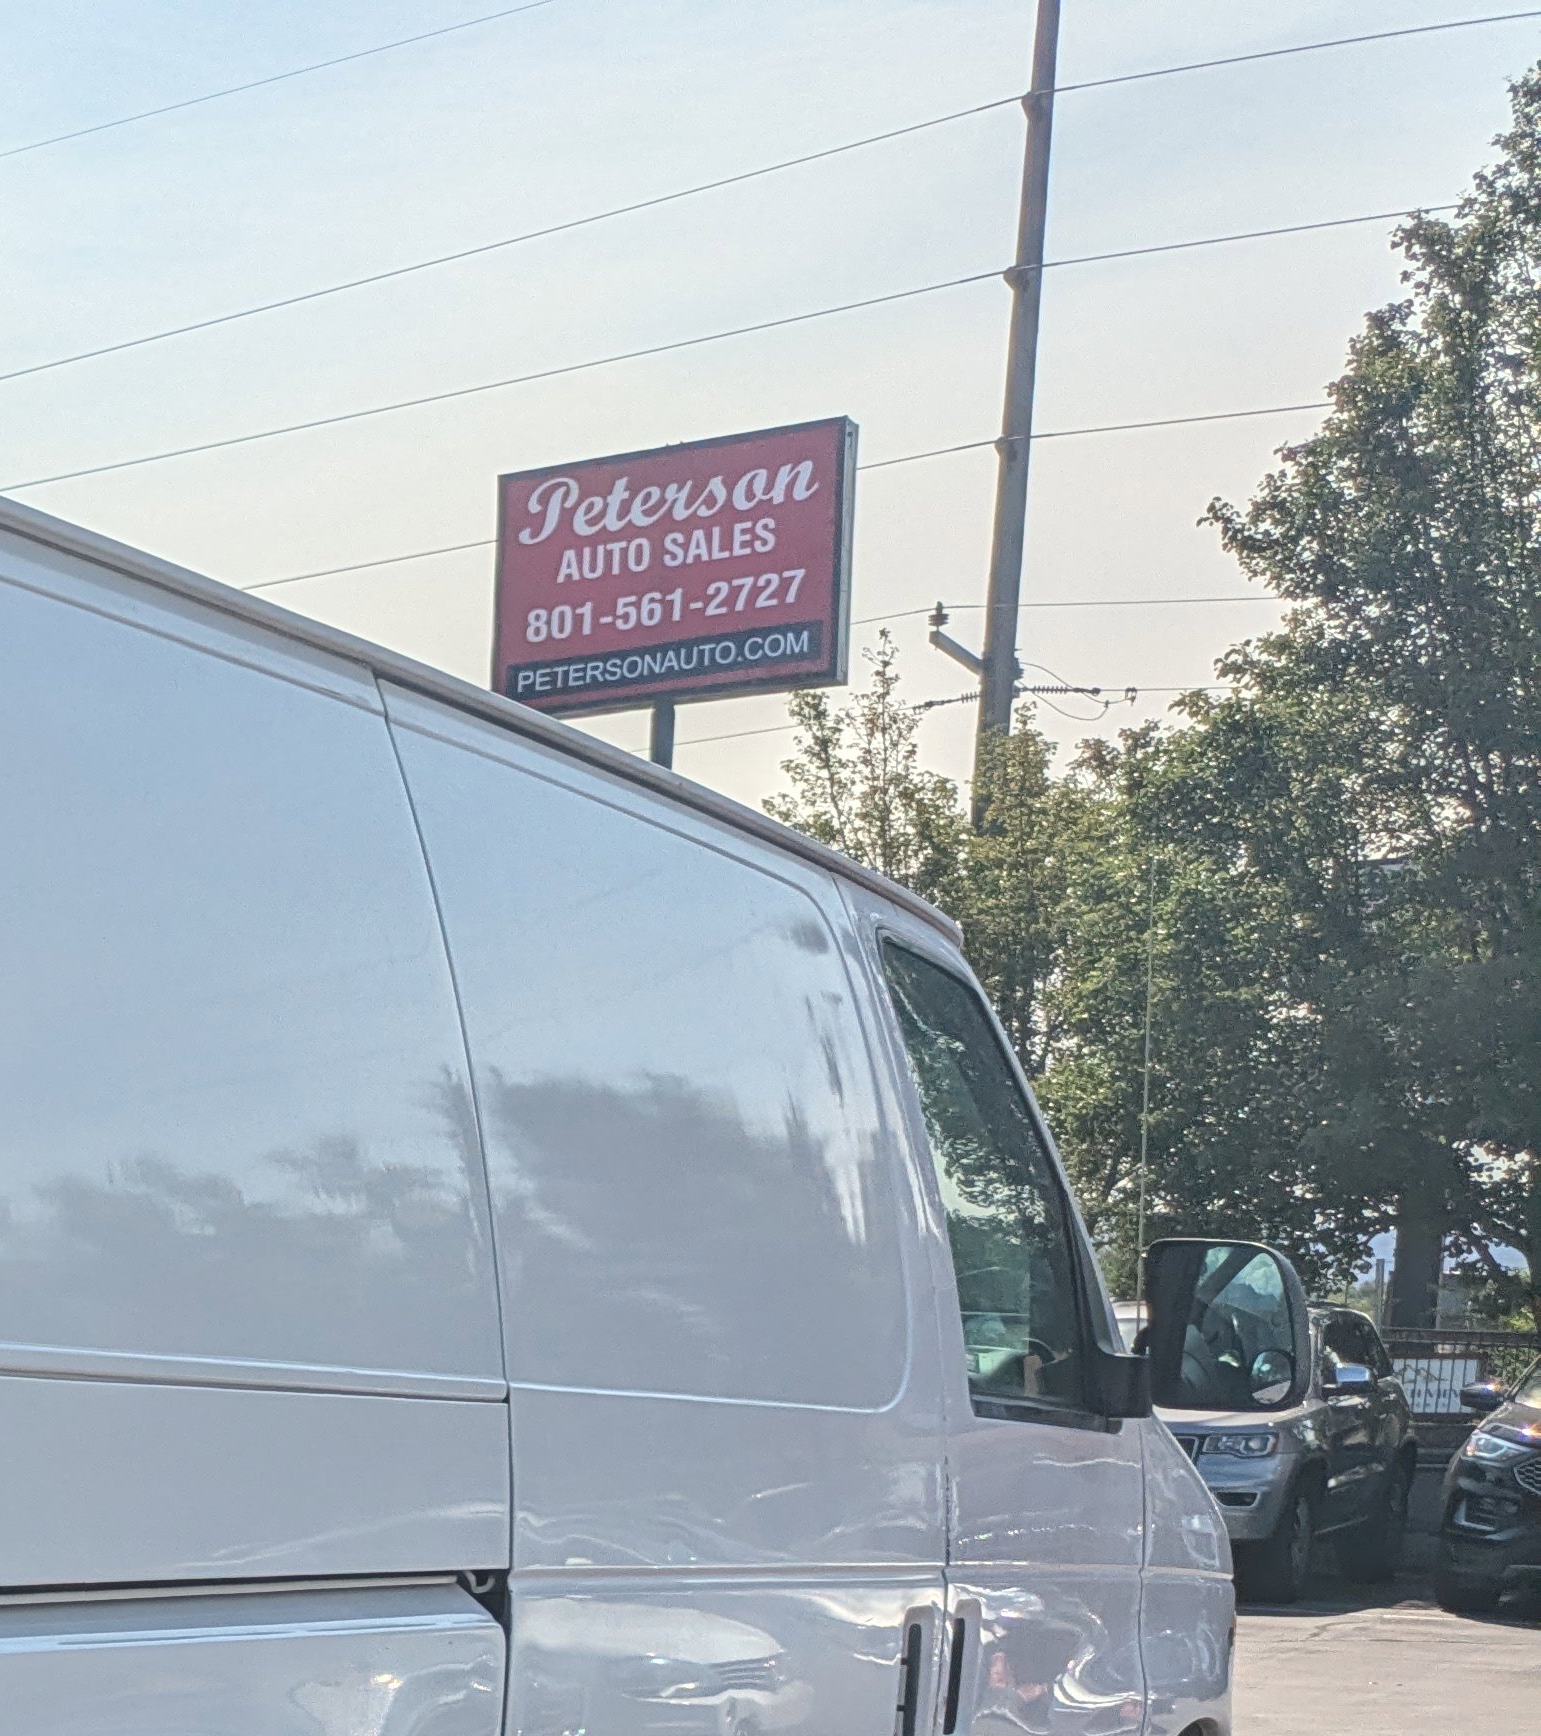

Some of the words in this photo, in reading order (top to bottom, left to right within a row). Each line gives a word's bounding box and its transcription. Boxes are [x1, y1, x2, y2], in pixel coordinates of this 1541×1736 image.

[518, 458, 820, 546] Peterson
[556, 537, 650, 584] AUTO
[663, 517, 777, 566] SALES
[526, 568, 806, 643] 801-561-2727
[516, 630, 810, 693] PETERSONAUTO.COM
